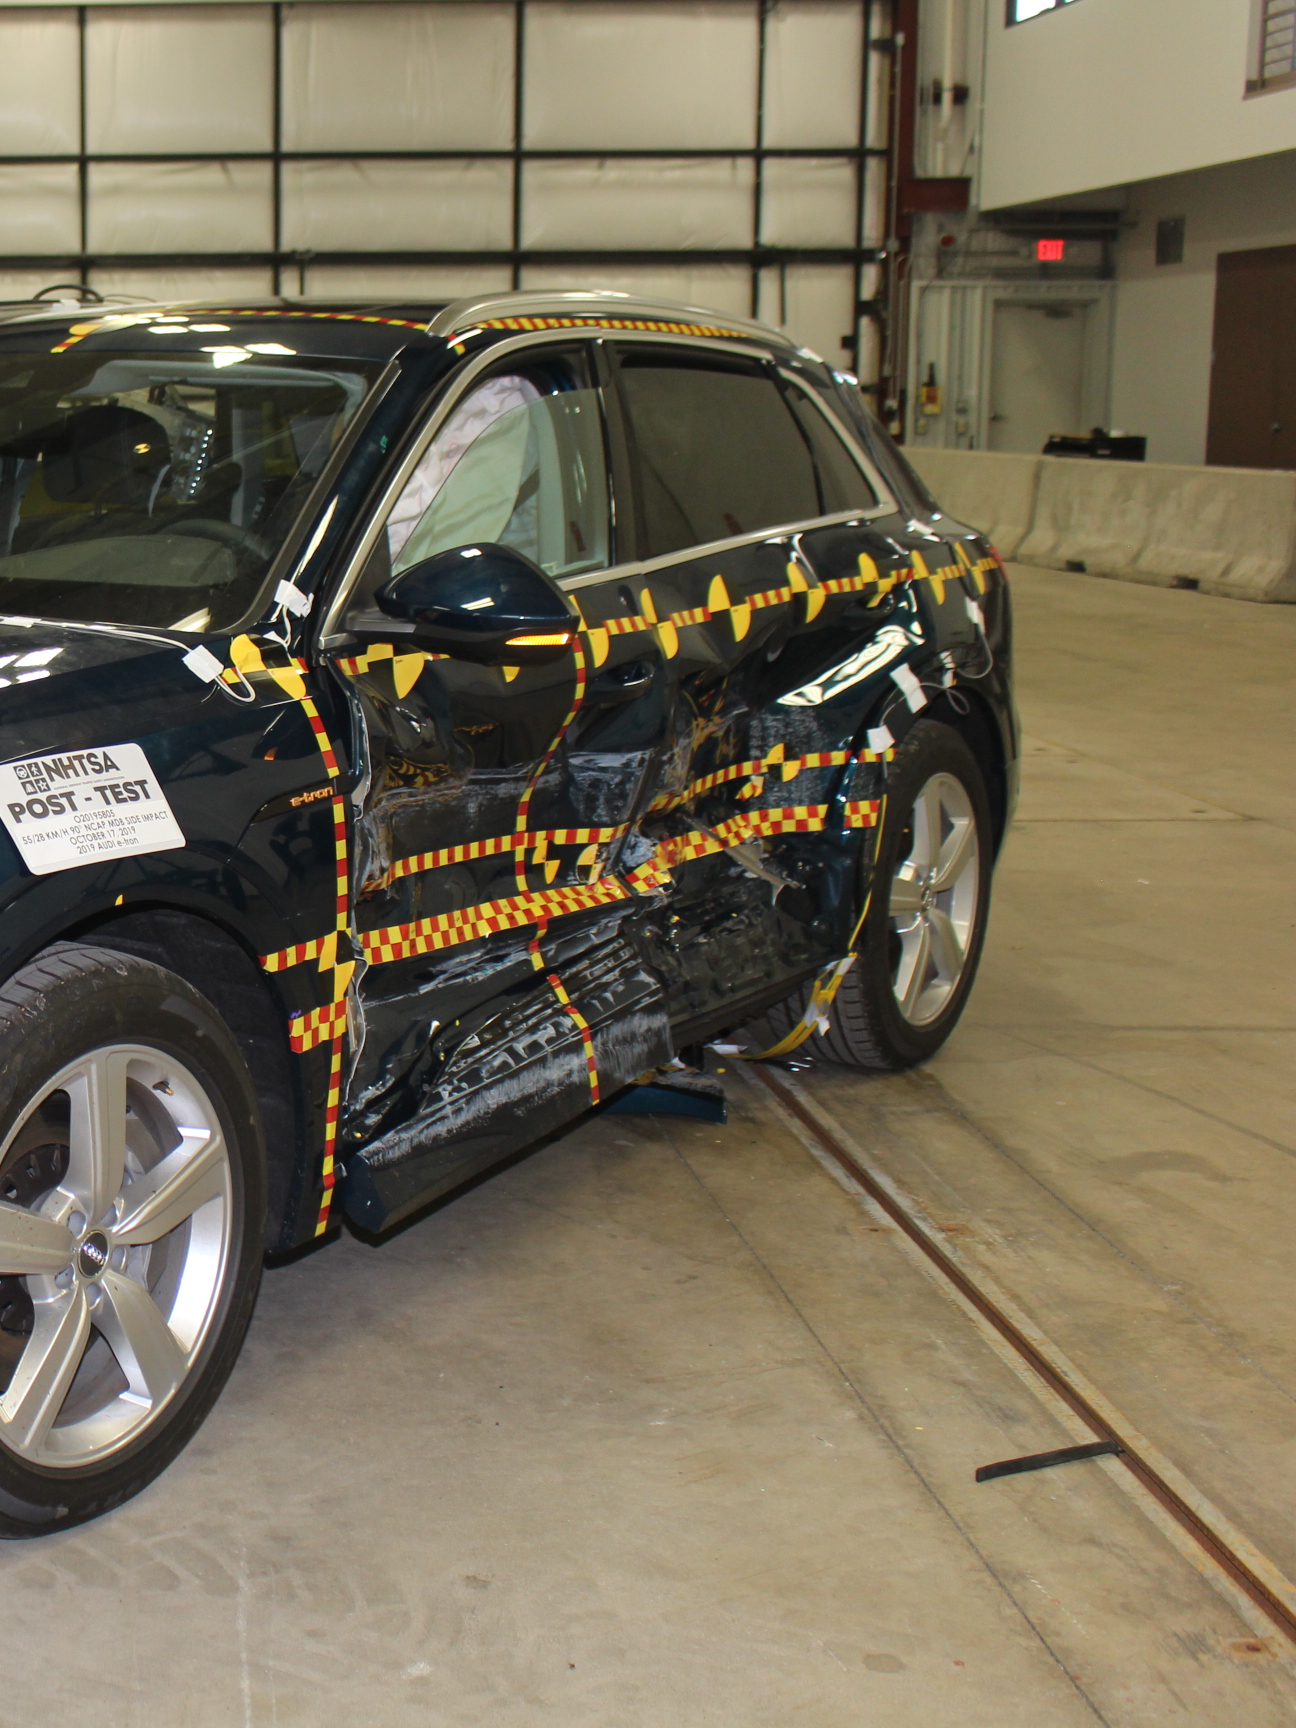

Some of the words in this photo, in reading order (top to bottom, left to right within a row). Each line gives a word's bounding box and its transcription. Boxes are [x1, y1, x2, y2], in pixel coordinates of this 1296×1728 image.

[1037, 239, 1065, 260] EXIT
[41, 751, 121, 782] NHTSA
[7, 791, 78, 824] POST
[94, 779, 151, 806] TEST
[289, 786, 334, 807] e-tron
[22, 833, 46, 845] 55/28
[45, 828, 70, 840] KM/H
[84, 821, 106, 832] NCAP
[107, 818, 125, 828] MDB
[125, 815, 142, 825] SIDE
[141, 811, 169, 822] IMPACT
[69, 831, 107, 846] OCTOBER
[120, 826, 136, 837] 2019
[77, 843, 96, 855] 2019
[97, 840, 117, 851] AUDI
[117, 837, 140, 847] e-tron
